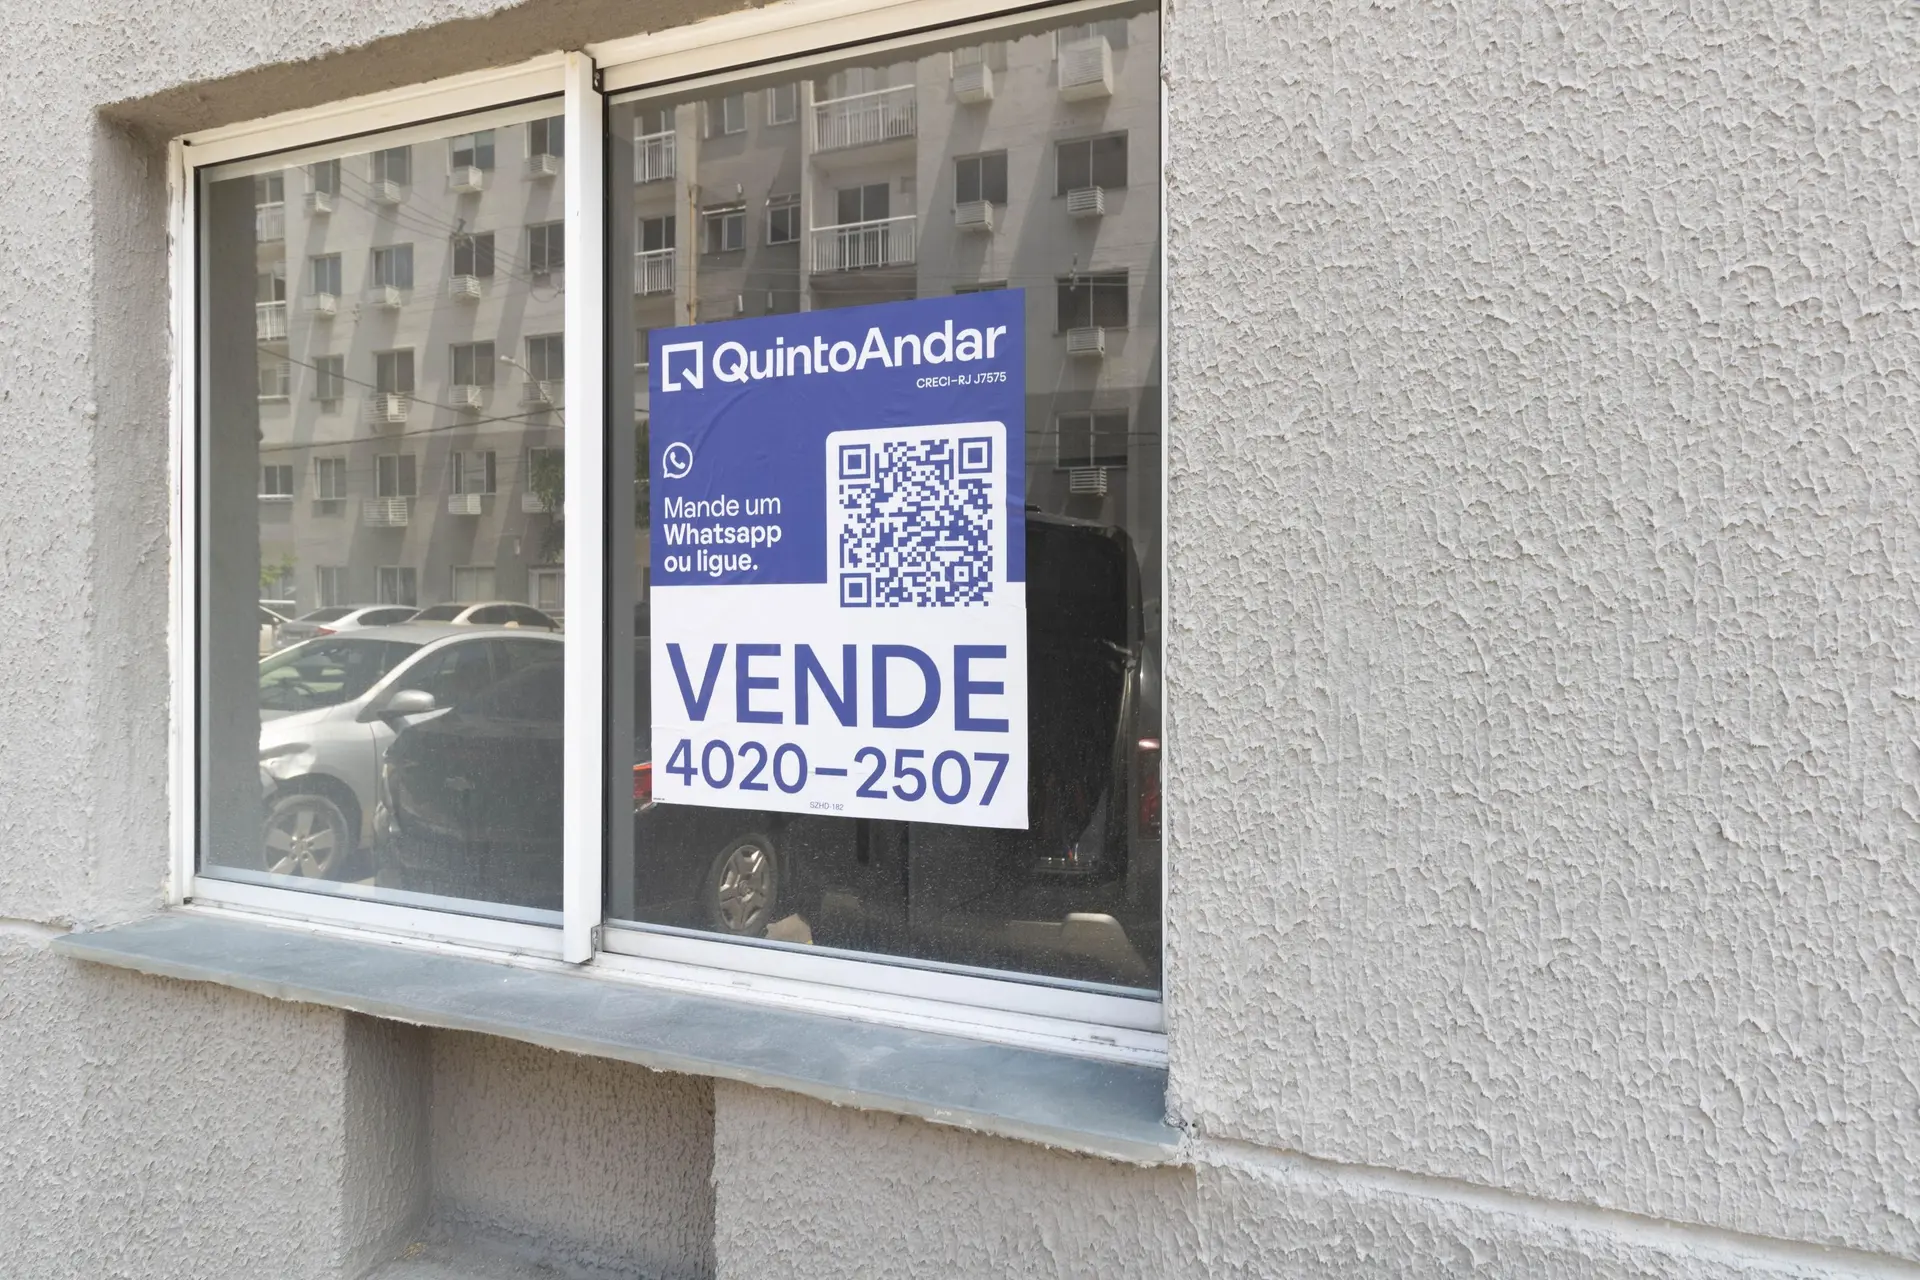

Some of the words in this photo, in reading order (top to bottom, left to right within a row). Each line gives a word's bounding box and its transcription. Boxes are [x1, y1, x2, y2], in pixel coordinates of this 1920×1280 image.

[713, 320, 1007, 383] QuintoAndar
[973, 371, 1007, 384] J7575
[664, 494, 740, 519] Mande
[745, 497, 781, 516] um
[663, 523, 782, 549] Whatsapp
[664, 555, 691, 573] ou
[697, 548, 758, 578] ligue.
[665, 642, 1010, 733] VENDE
[665, 738, 1010, 806] 4020-2507
